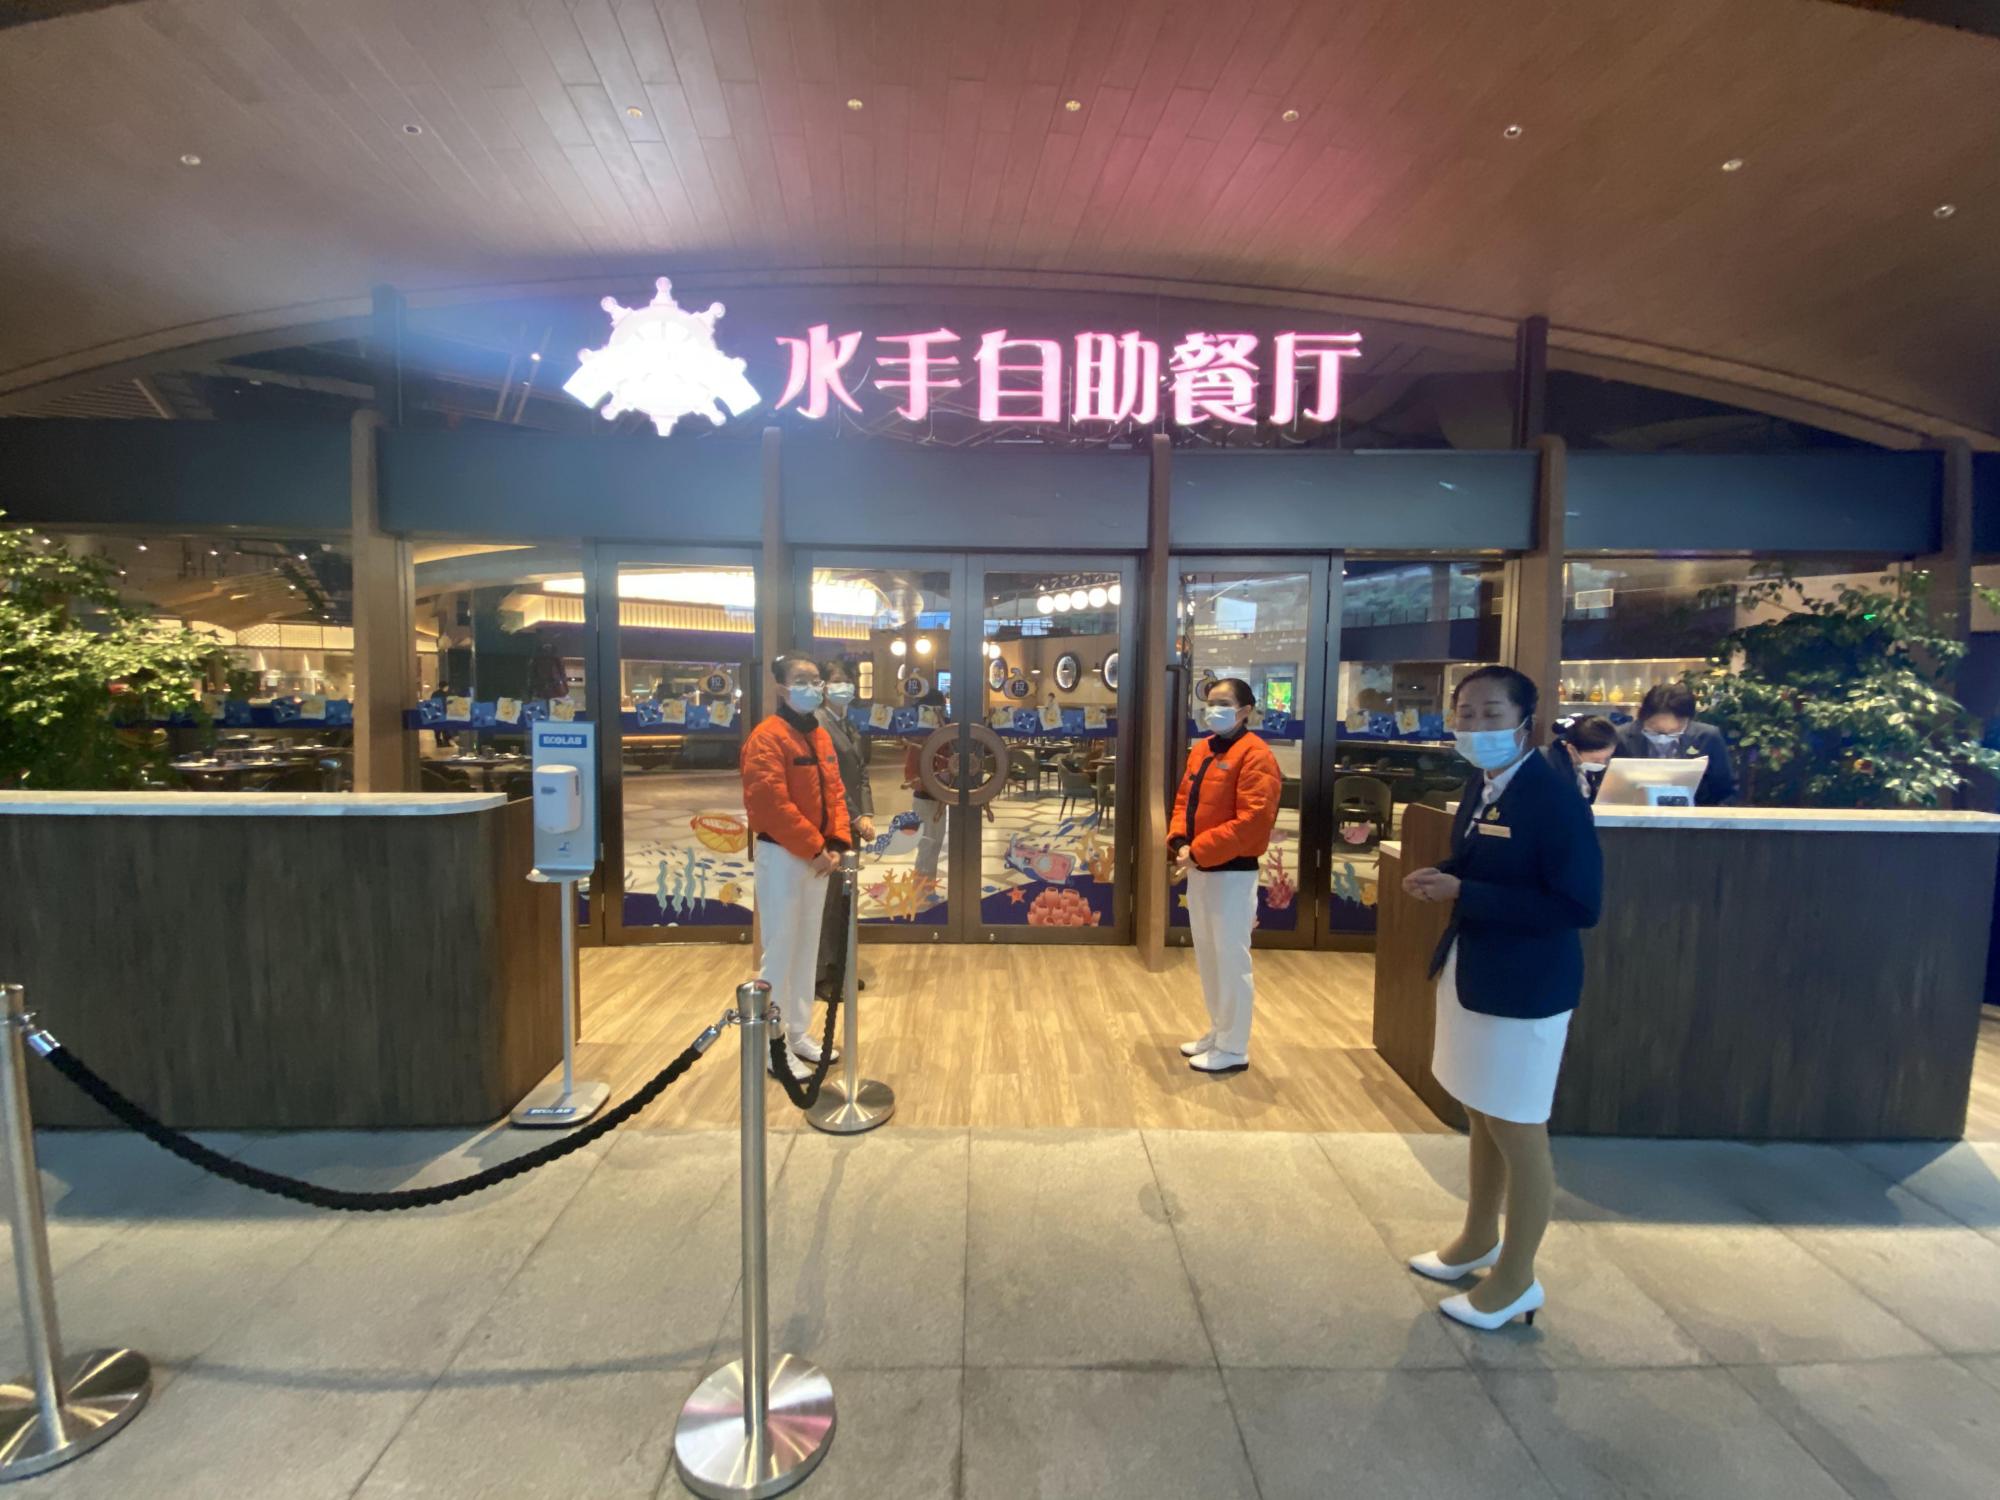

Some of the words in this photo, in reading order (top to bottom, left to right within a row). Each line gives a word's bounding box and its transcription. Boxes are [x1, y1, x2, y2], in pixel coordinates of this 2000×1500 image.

[774, 323, 1364, 426] 水手自助餐厅
[543, 735, 583, 745] ECOLAB
